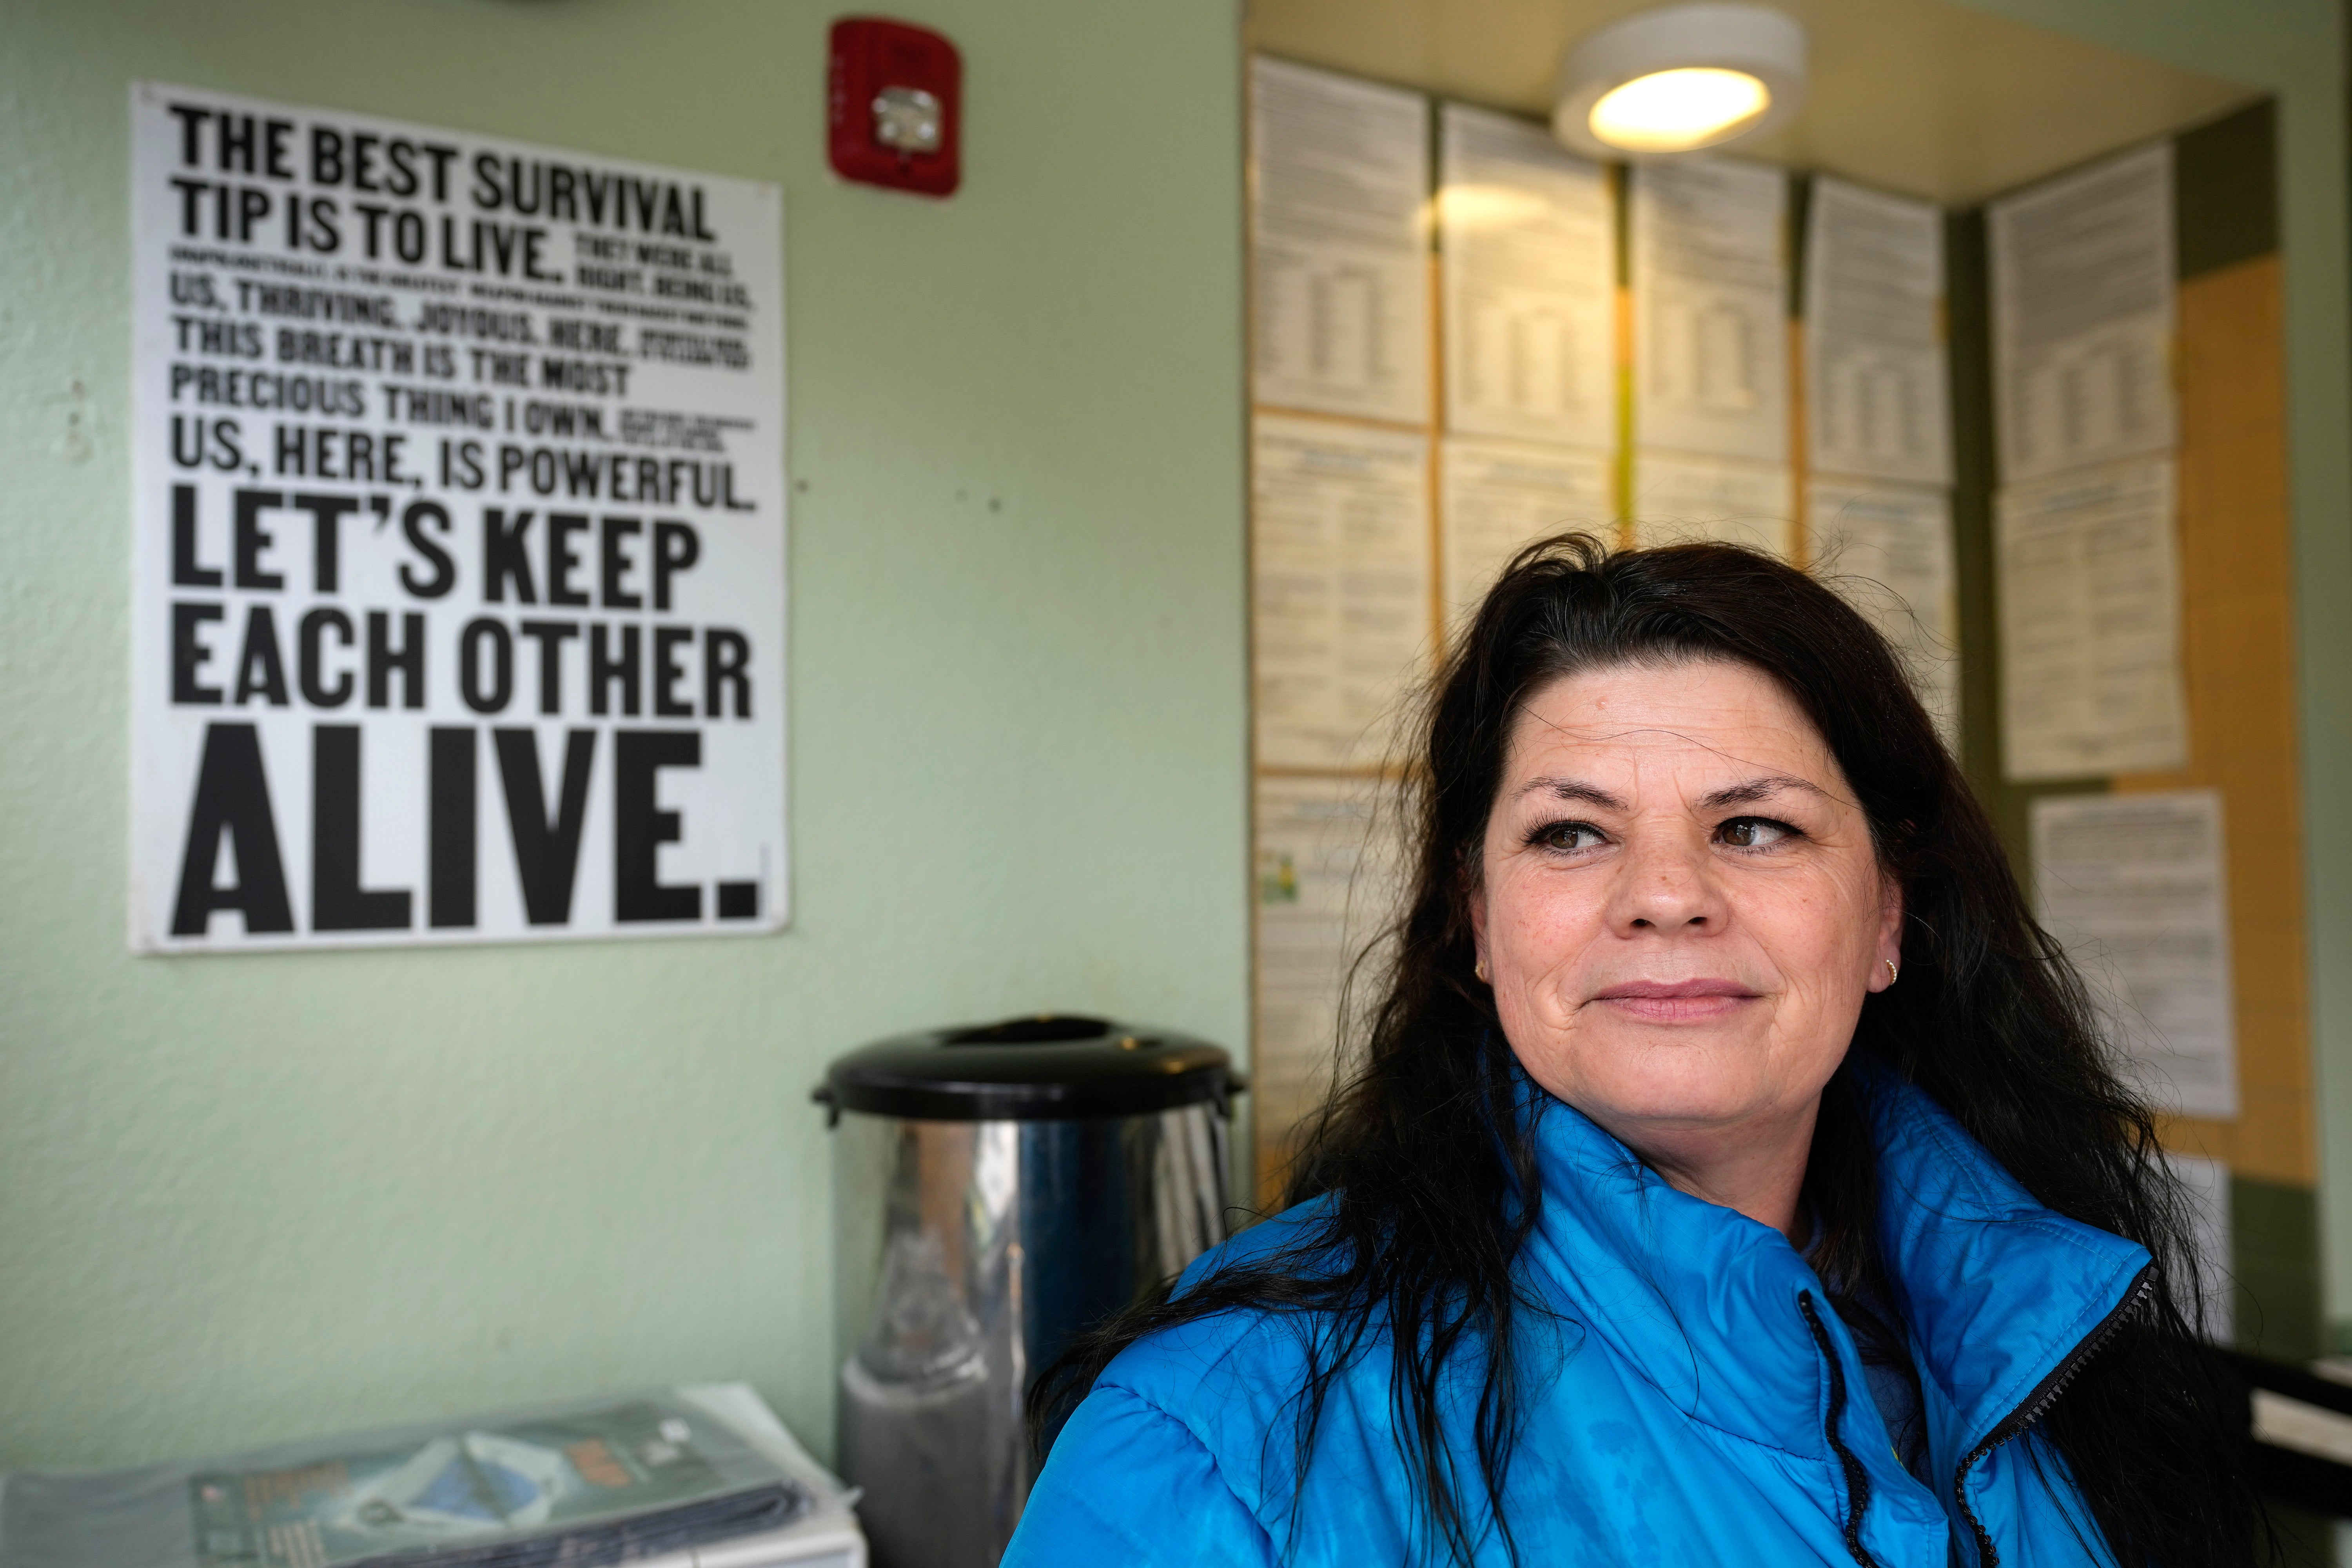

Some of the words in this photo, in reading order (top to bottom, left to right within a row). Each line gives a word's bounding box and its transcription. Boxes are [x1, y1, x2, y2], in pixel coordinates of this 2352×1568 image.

[169, 101, 296, 182] THE
[310, 124, 461, 203] BEST
[471, 152, 717, 244] SURVIVAL
[169, 175, 274, 245] TIP
[285, 193, 343, 255] IS
[353, 201, 428, 266] TO
[442, 214, 566, 285] LIVE.
[170, 314, 265, 362] THIS
[276, 325, 414, 376] BREATH
[423, 341, 457, 381] IS
[466, 346, 533, 389] THE
[541, 355, 633, 399] MOST
[170, 362, 368, 420] PRECIOUS
[378, 383, 495, 432] THING
[505, 396, 516, 436] I
[523, 399, 615, 443] OWN.
[170, 412, 262, 486] US,
[274, 422, 424, 499] HERE,
[439, 435, 487, 493] IS
[497, 442, 758, 514] POWERFUL.
[170, 479, 459, 603] LET'S
[481, 505, 703, 613] KEEP
[170, 599, 428, 711] EACH
[456, 614, 755, 722] OTHER
[167, 719, 761, 939] ALIVE.
